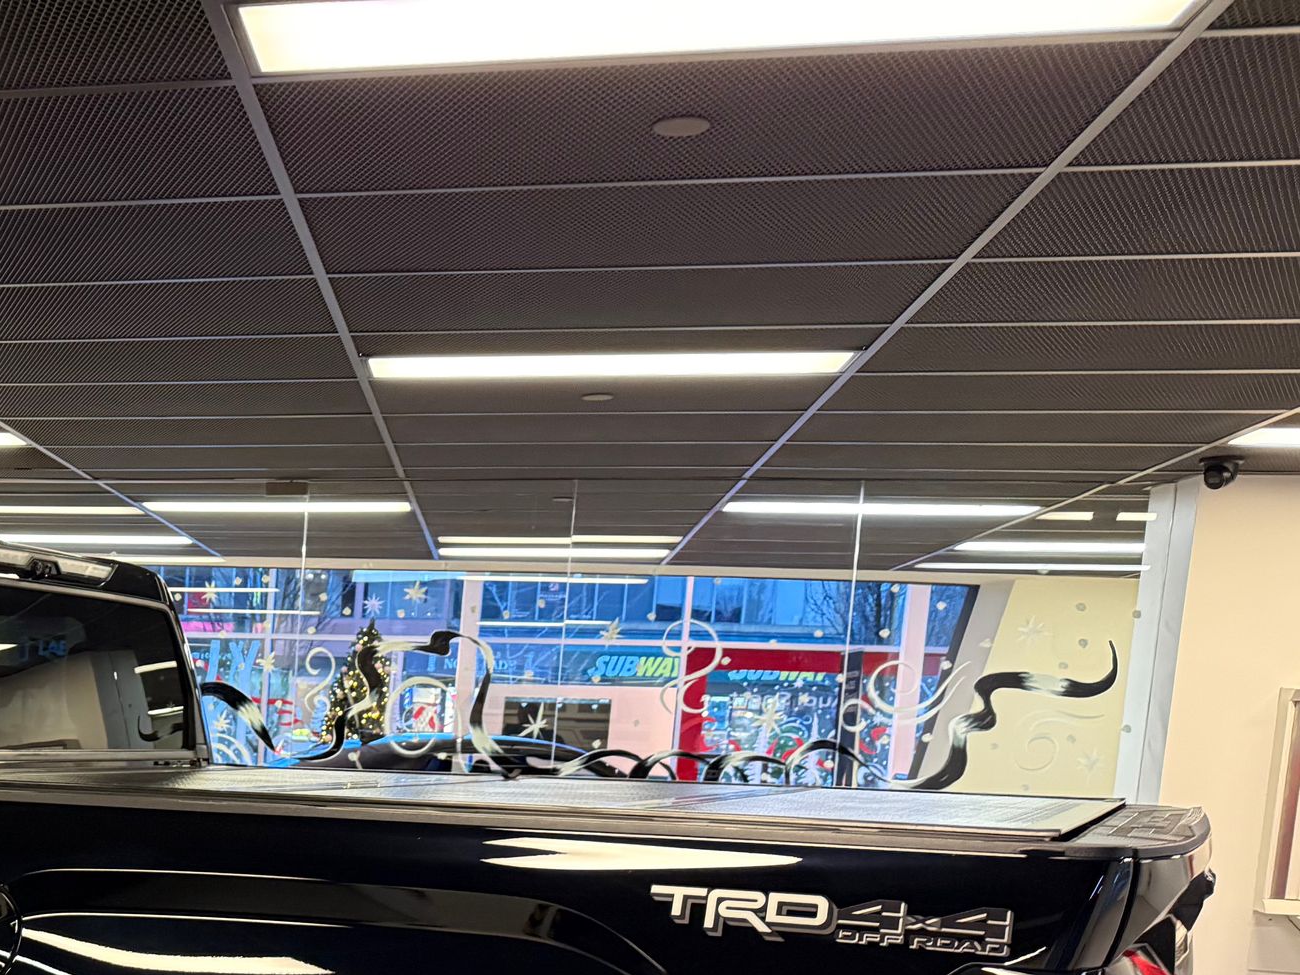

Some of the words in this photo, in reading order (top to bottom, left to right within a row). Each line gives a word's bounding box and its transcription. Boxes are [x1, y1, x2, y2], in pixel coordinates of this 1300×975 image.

[651, 884, 836, 941] TRD
[836, 930, 904, 947] OFF
[908, 936, 1012, 957] ROAD
